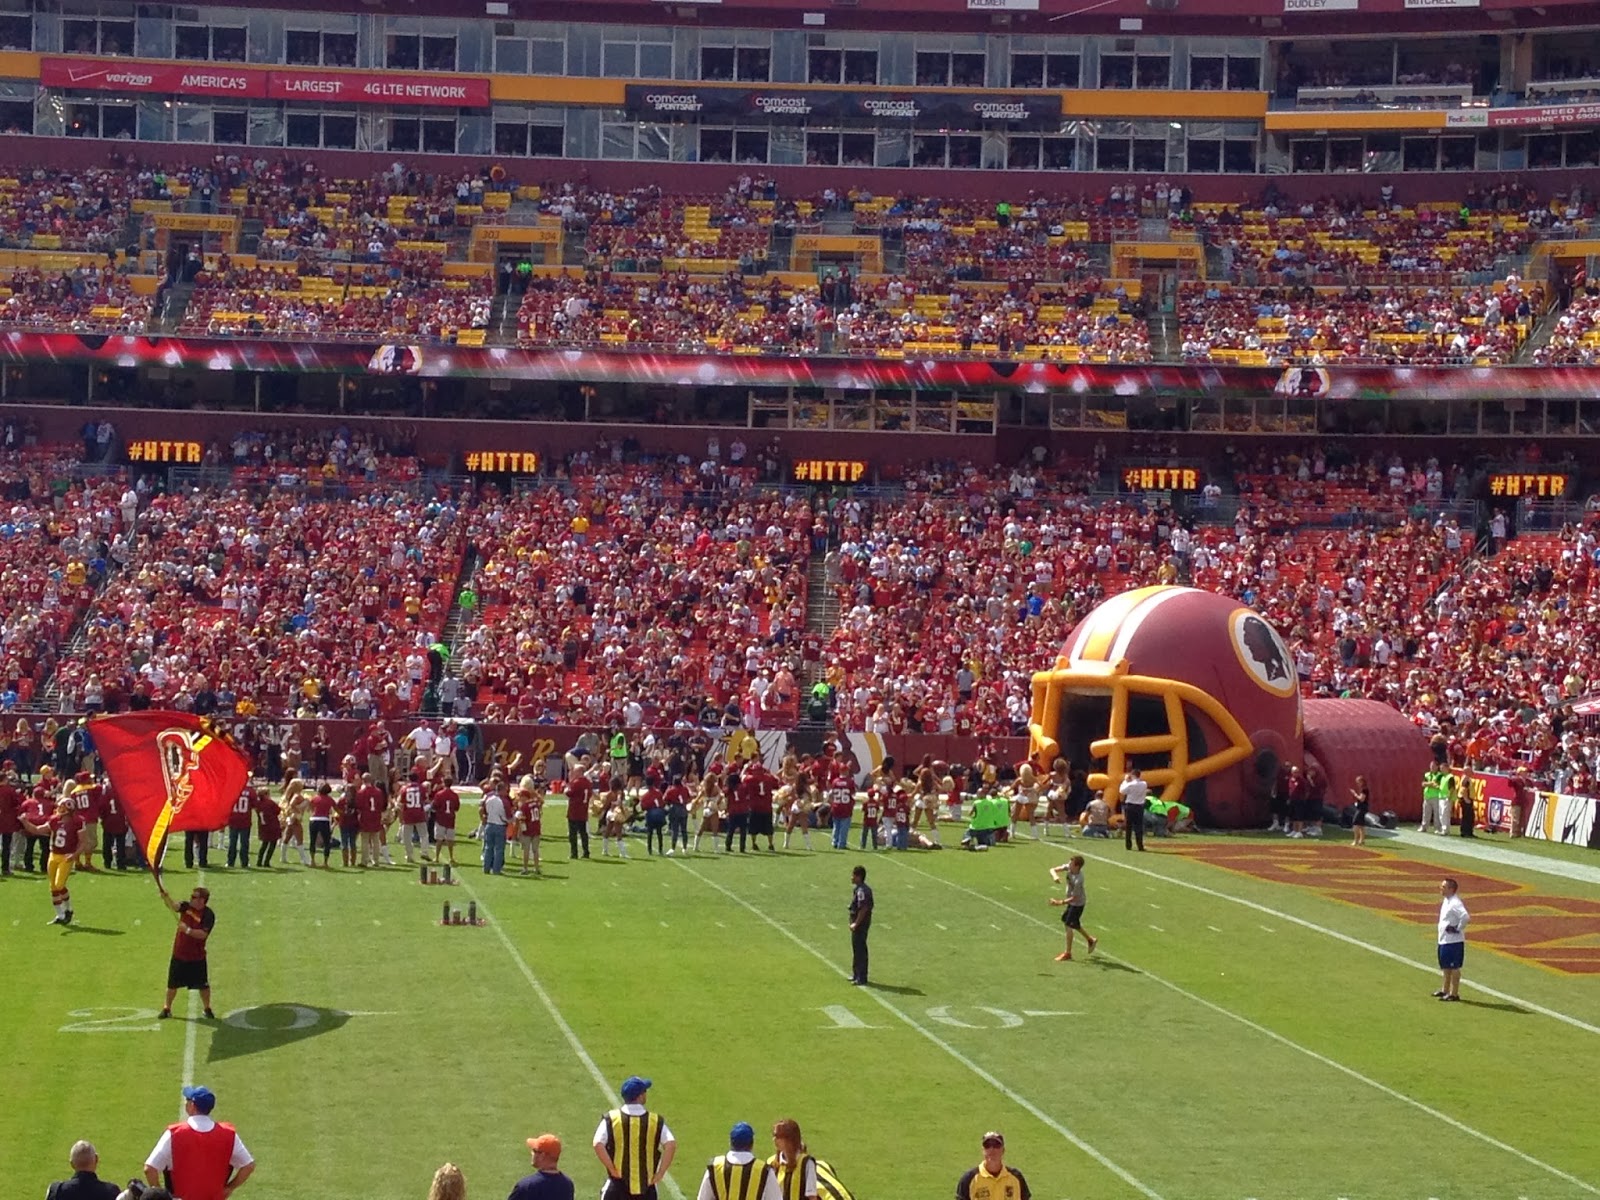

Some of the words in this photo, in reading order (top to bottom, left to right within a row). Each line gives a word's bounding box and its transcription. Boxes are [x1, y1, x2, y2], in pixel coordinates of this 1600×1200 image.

[1287, 0, 1326, 8] DUDLEY
[105, 72, 153, 86] verizon
[181, 75, 247, 90] AMERICA'S
[285, 79, 342, 93] LARGEST
[363, 83, 380, 95] 4G
[382, 84, 403, 96] LTE
[406, 85, 466, 98] NETWORK
[646, 94, 697, 103] comcast
[755, 97, 806, 106] comcast
[864, 100, 915, 109] comcast
[655, 103, 703, 111] SPORTSNET
[764, 106, 812, 114] SPORTSNET
[872, 109, 921, 117] SPORTSNET
[973, 102, 1024, 112] comcast
[1541, 107, 1575, 116] NEED
[981, 111, 1031, 119] SPORTSNET
[1561, 114, 1574, 122] TO
[128, 441, 201, 463] #HTTR
[465, 452, 536, 473] #HTTR
[1125, 469, 1196, 489] #HTTR
[1490, 475, 1564, 496] #HTTR
[76, 794, 90, 809] 10
[406, 791, 421, 808] 91
[833, 788, 851, 804] 26
[55, 828, 67, 848] 6
